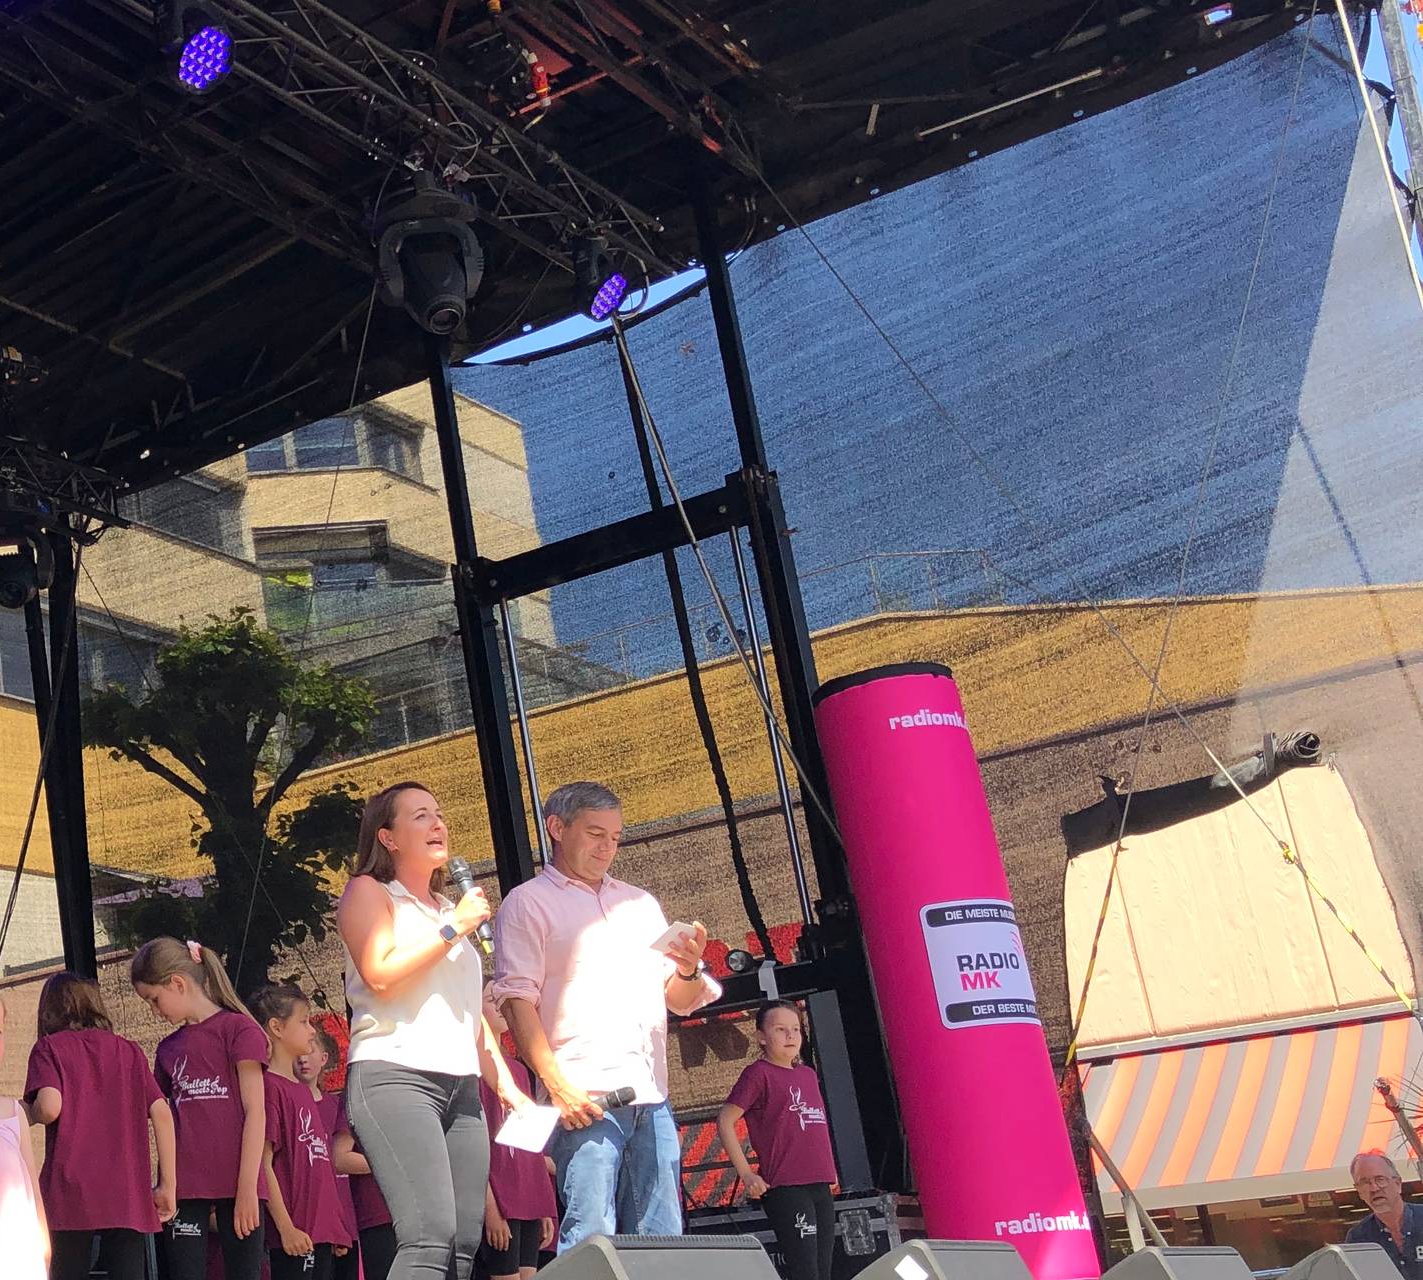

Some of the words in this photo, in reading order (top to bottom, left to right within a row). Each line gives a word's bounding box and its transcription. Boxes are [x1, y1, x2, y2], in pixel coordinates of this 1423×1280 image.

[888, 708, 968, 730] radiomk.
[944, 910, 964, 920] DIE
[965, 908, 999, 919] MEISTE
[999, 908, 1016, 921] MUS
[956, 952, 1020, 973] RADIO
[960, 971, 1001, 993] MK
[972, 1004, 996, 1016] DER
[997, 1003, 1026, 1013] BESTE
